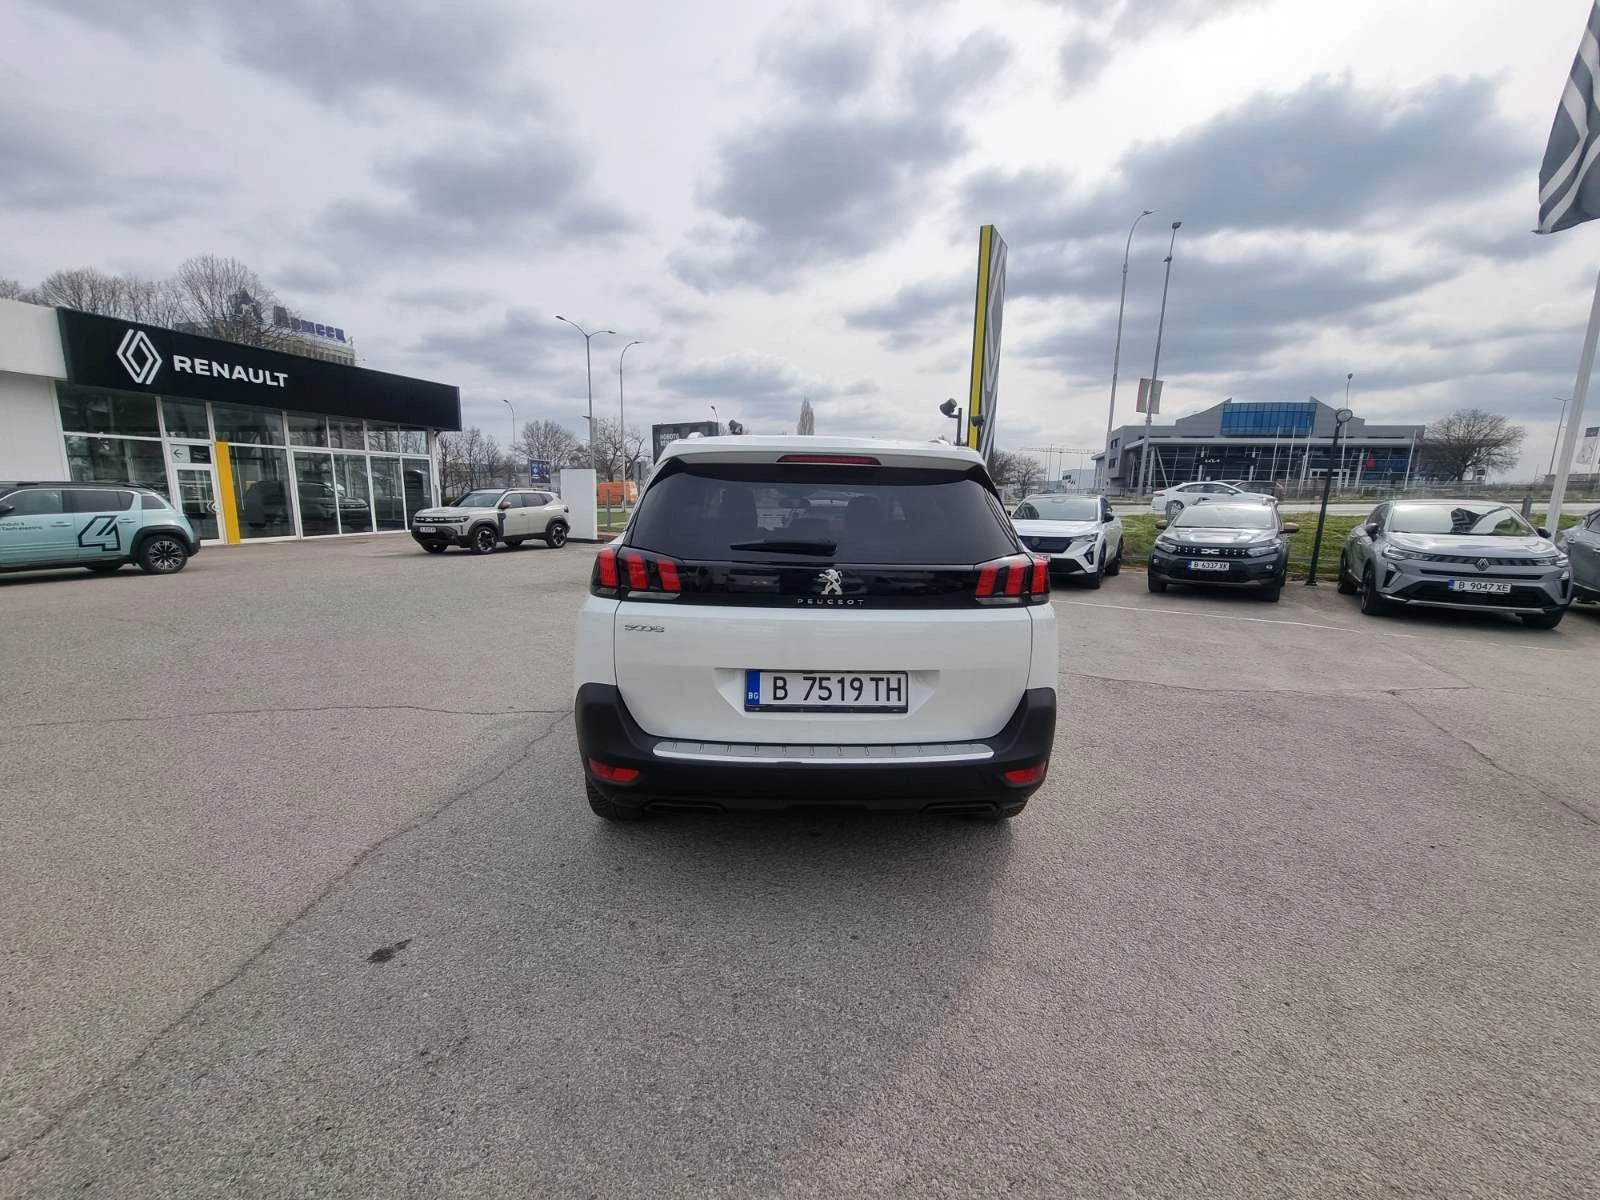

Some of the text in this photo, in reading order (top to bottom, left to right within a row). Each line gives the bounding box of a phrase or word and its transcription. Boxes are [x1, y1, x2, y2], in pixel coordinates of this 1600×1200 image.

[173, 355, 288, 387] RENAULT
[1458, 581, 1509, 592] B 9047 XE
[748, 676, 902, 702] BG B 7519 TH
